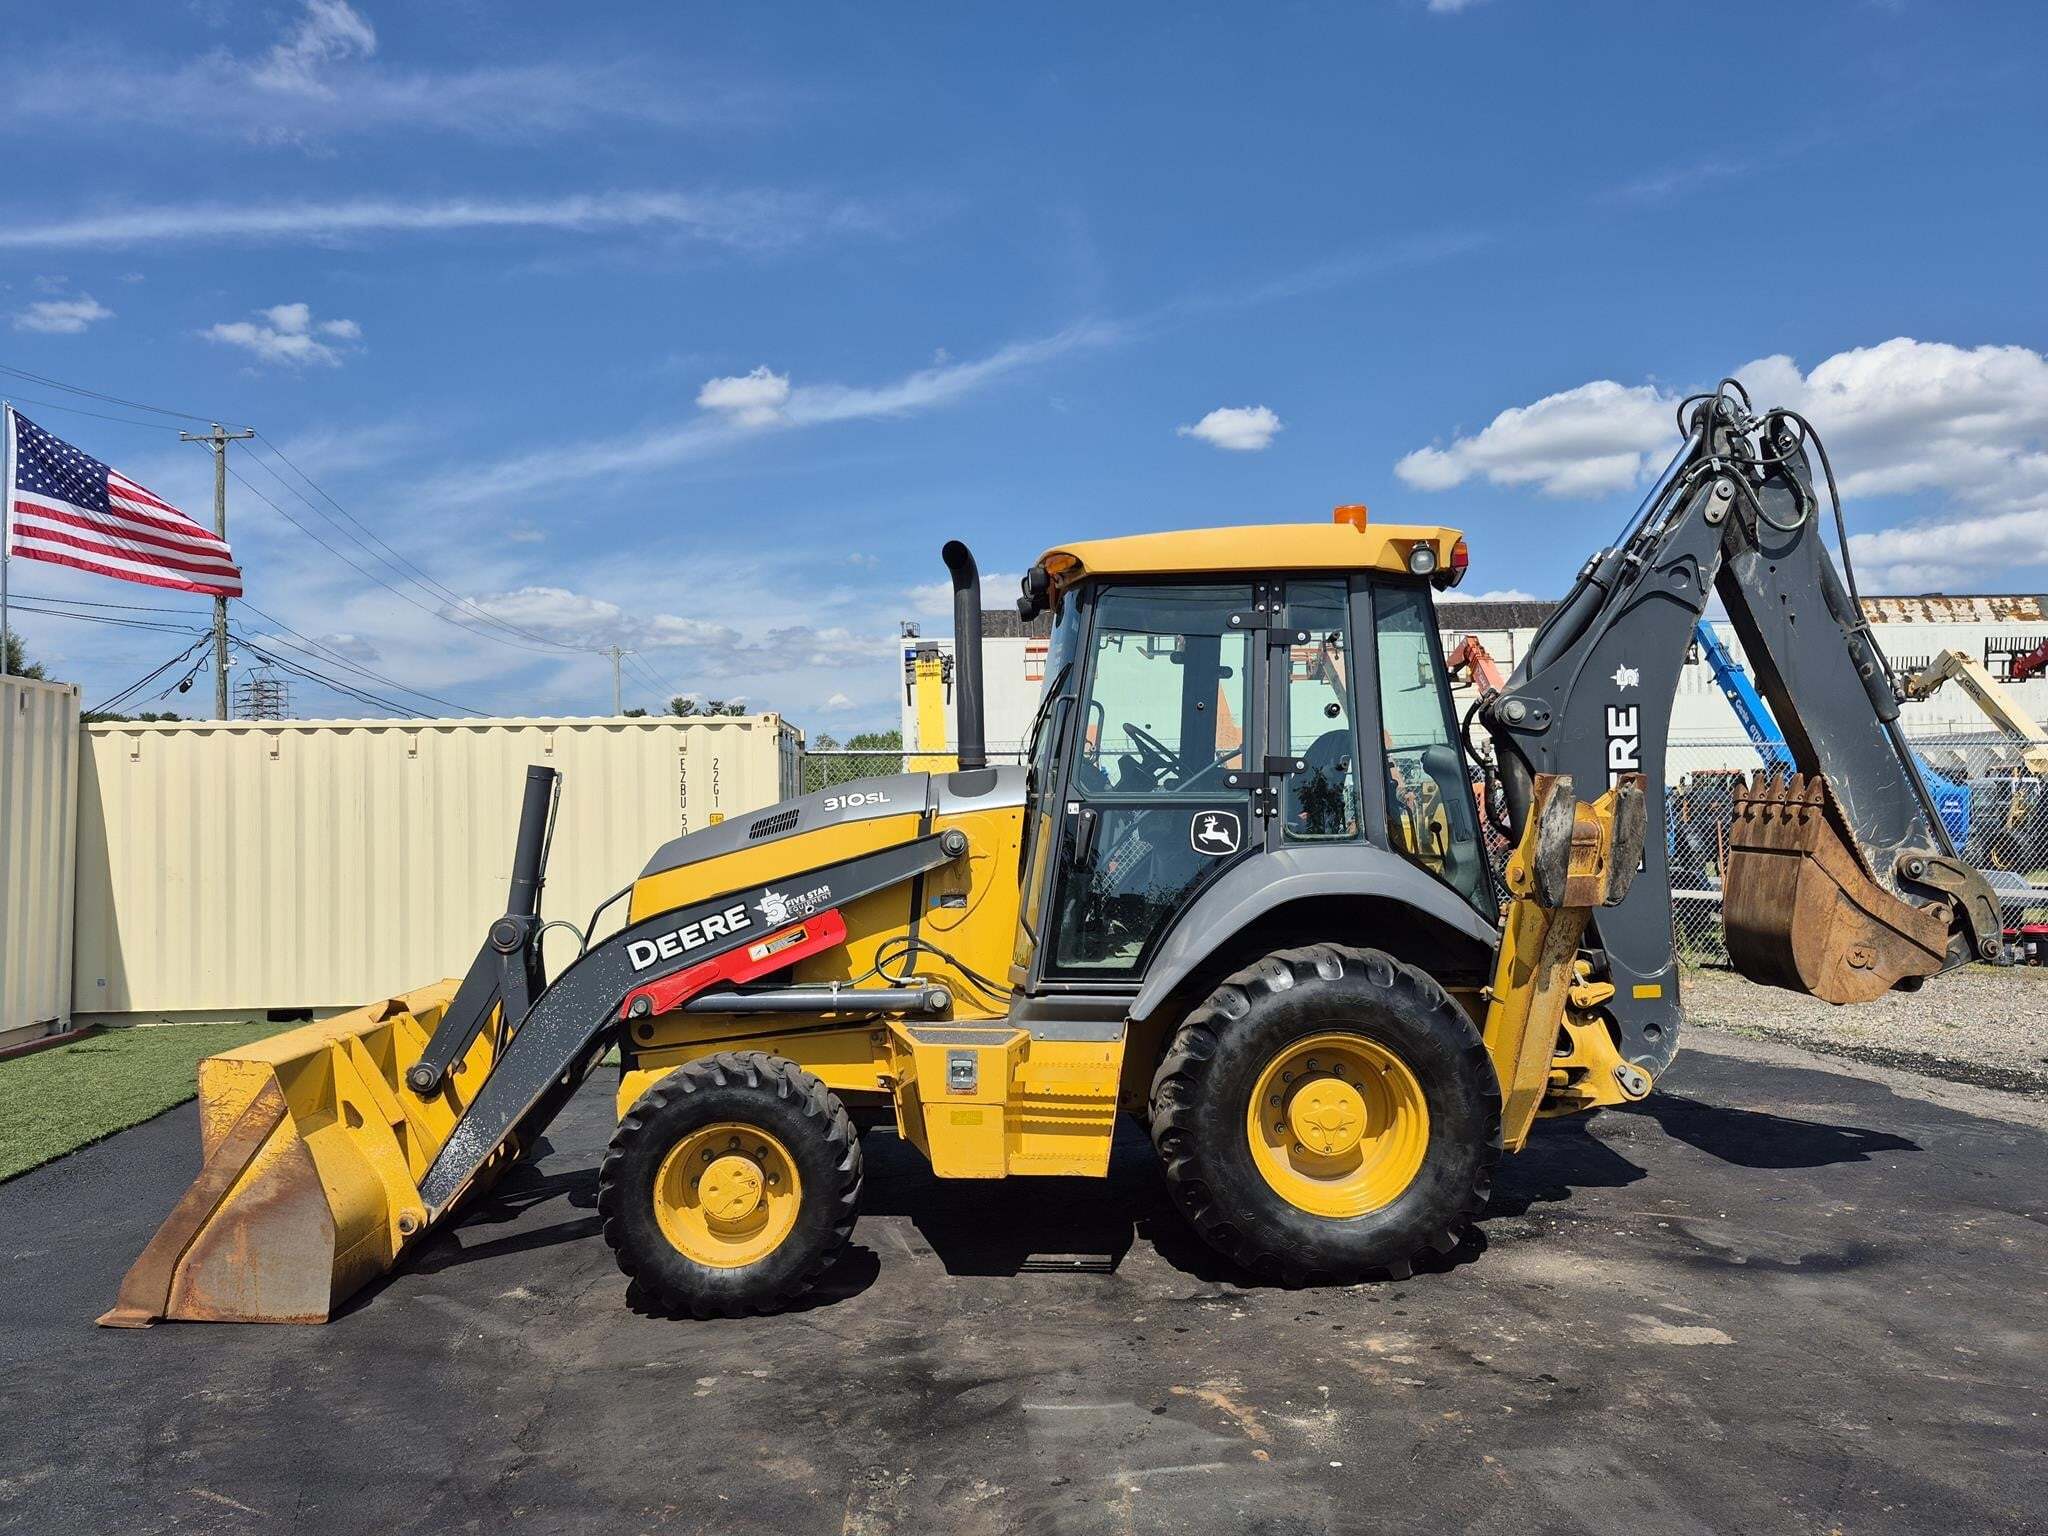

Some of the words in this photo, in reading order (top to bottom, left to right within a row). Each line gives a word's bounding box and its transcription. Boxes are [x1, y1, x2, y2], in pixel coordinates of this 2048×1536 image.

[1964, 680, 1982, 700] GEHL
[824, 792, 891, 811] 310SL
[785, 895, 806, 907] FIVE
[807, 885, 830, 899] STAR
[760, 893, 787, 925] 5
[626, 904, 751, 971] DEERE
